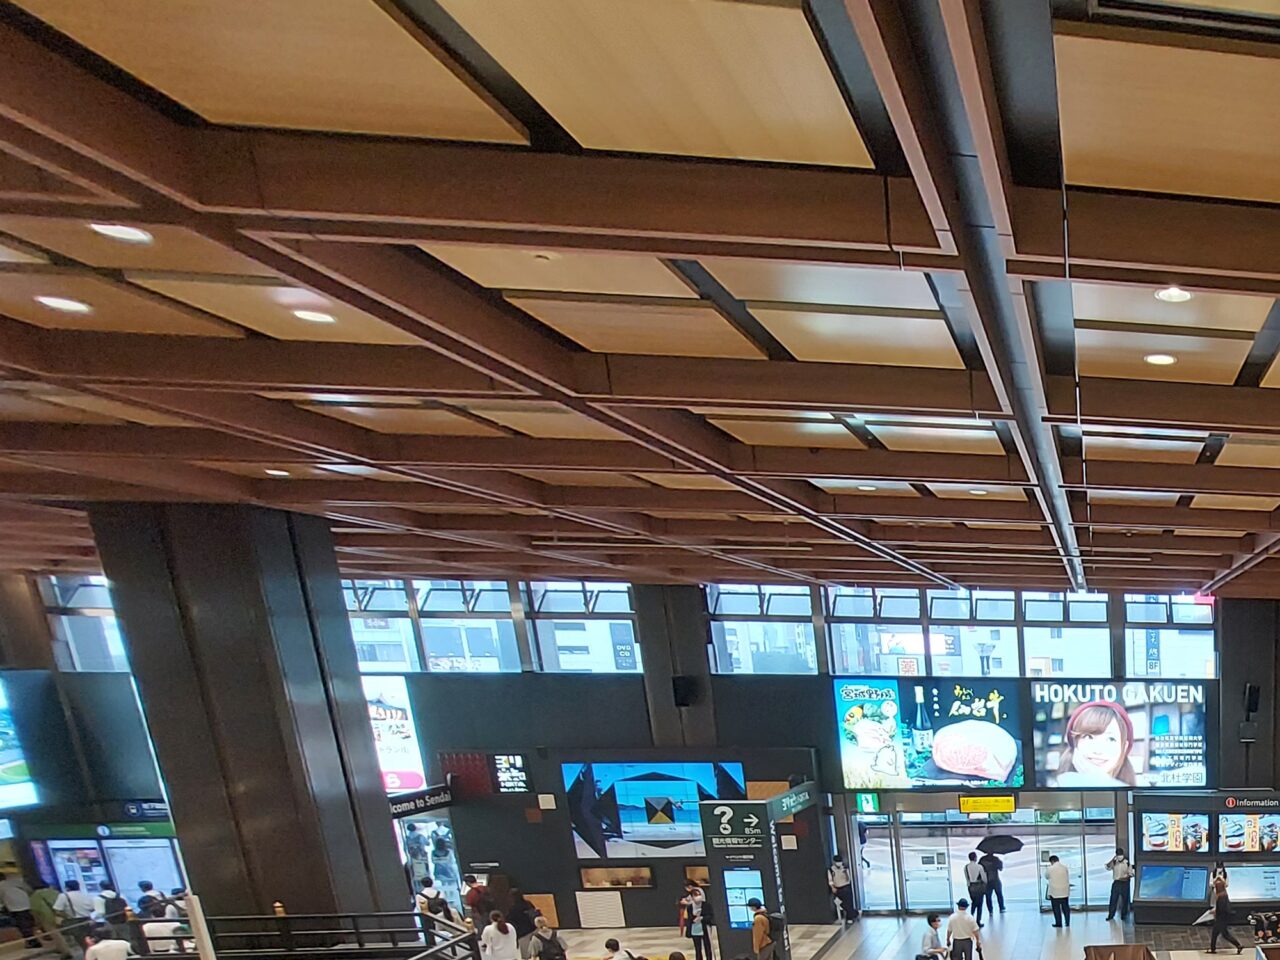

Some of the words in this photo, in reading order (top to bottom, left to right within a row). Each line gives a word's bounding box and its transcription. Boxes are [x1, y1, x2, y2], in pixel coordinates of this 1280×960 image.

[1148, 661, 1159, 670] 8F
[1035, 684, 1117, 703] HOKUTO
[1122, 685, 1203, 703] GAKUEN
[1160, 772, 1203, 785] 北杜学園
[416, 797, 425, 808] to
[425, 791, 451, 807] Sendai
[1237, 799, 1279, 807] Information
[744, 827, 761, 835] 85m
[769, 820, 781, 886] Welcome
